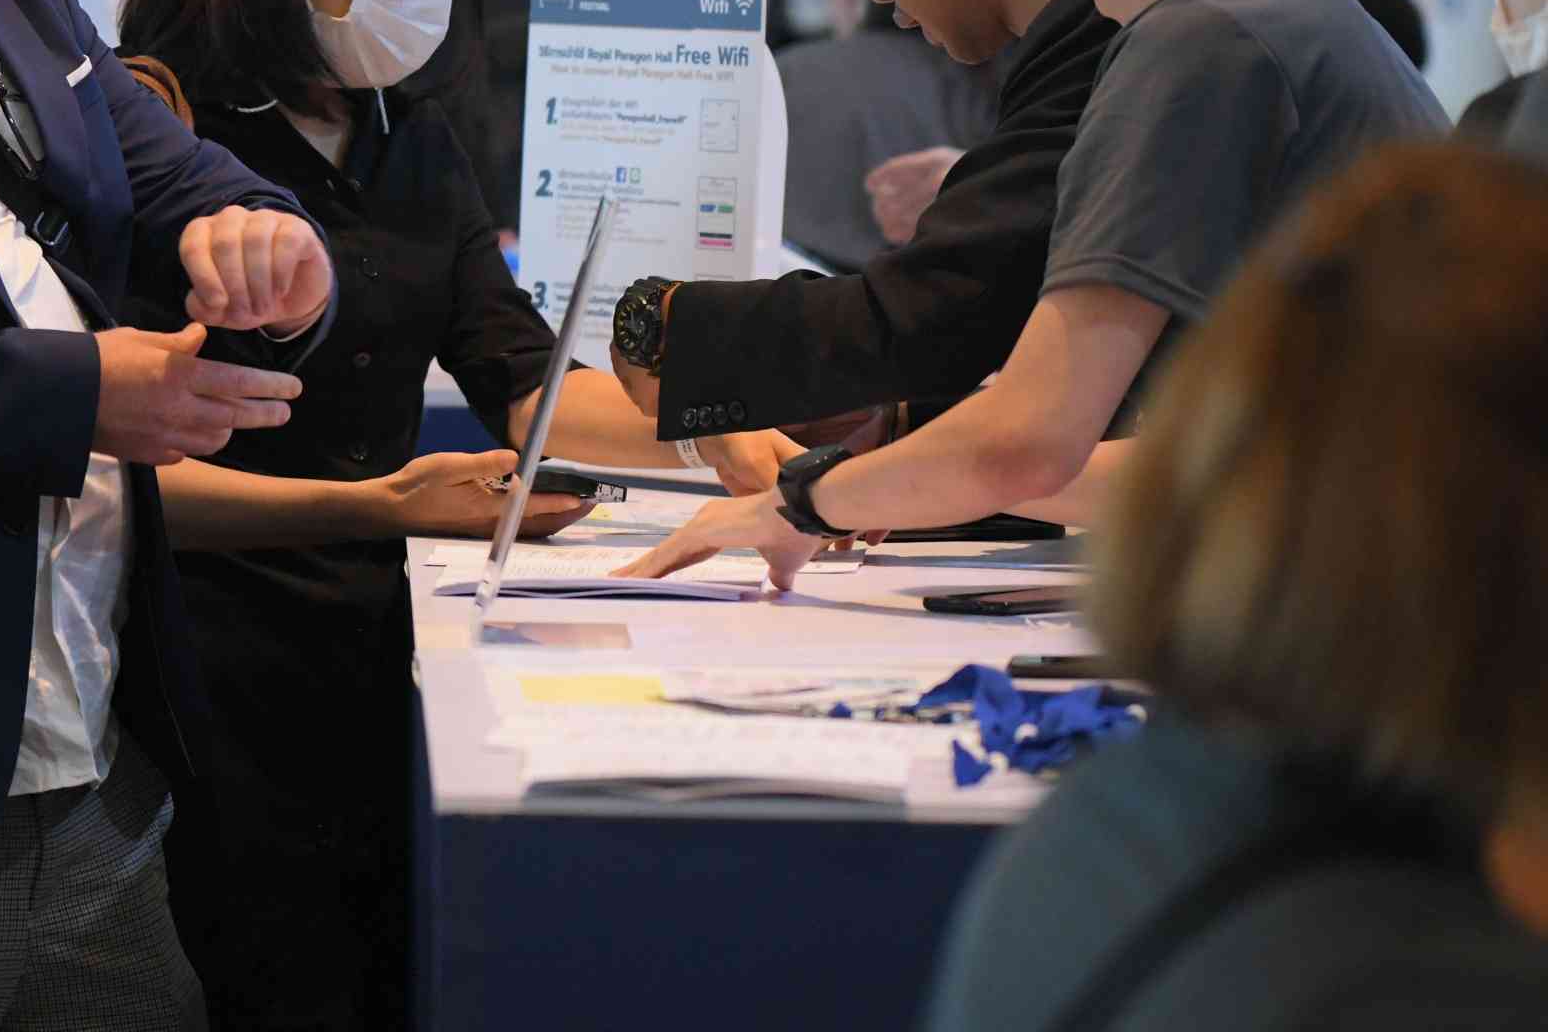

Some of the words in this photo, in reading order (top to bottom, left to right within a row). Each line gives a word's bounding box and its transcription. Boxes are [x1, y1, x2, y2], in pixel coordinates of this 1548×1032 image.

[615, 49, 652, 65] Paragon
[676, 44, 711, 65] Free
[717, 45, 749, 67] Wifi
